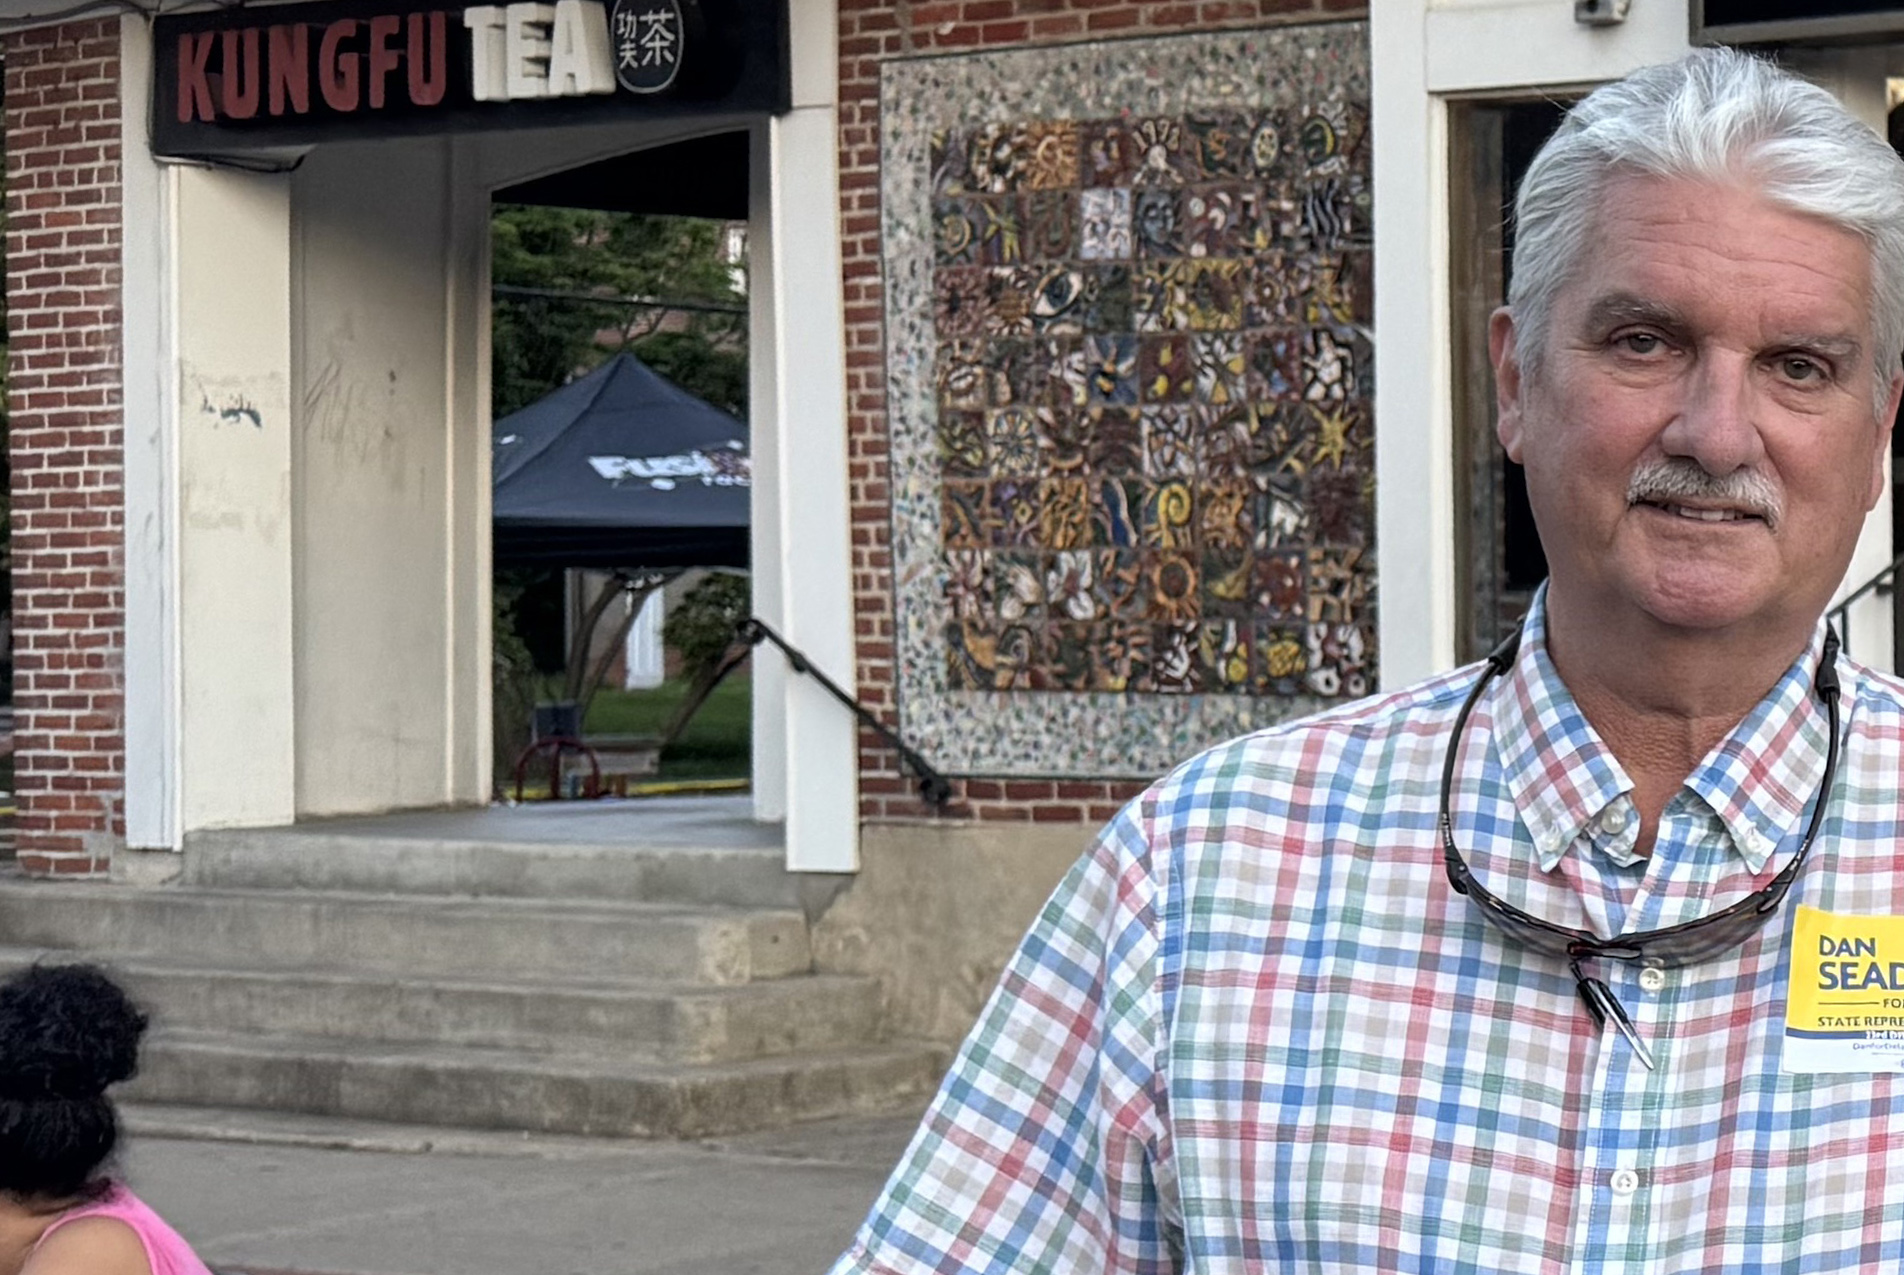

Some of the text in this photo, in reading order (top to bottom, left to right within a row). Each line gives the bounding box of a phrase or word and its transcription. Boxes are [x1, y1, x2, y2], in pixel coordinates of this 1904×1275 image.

[177, 0, 613, 123] KUNGFU TEA
[1819, 934, 1876, 957] DAN
[1817, 1016, 1861, 1027] STATE
